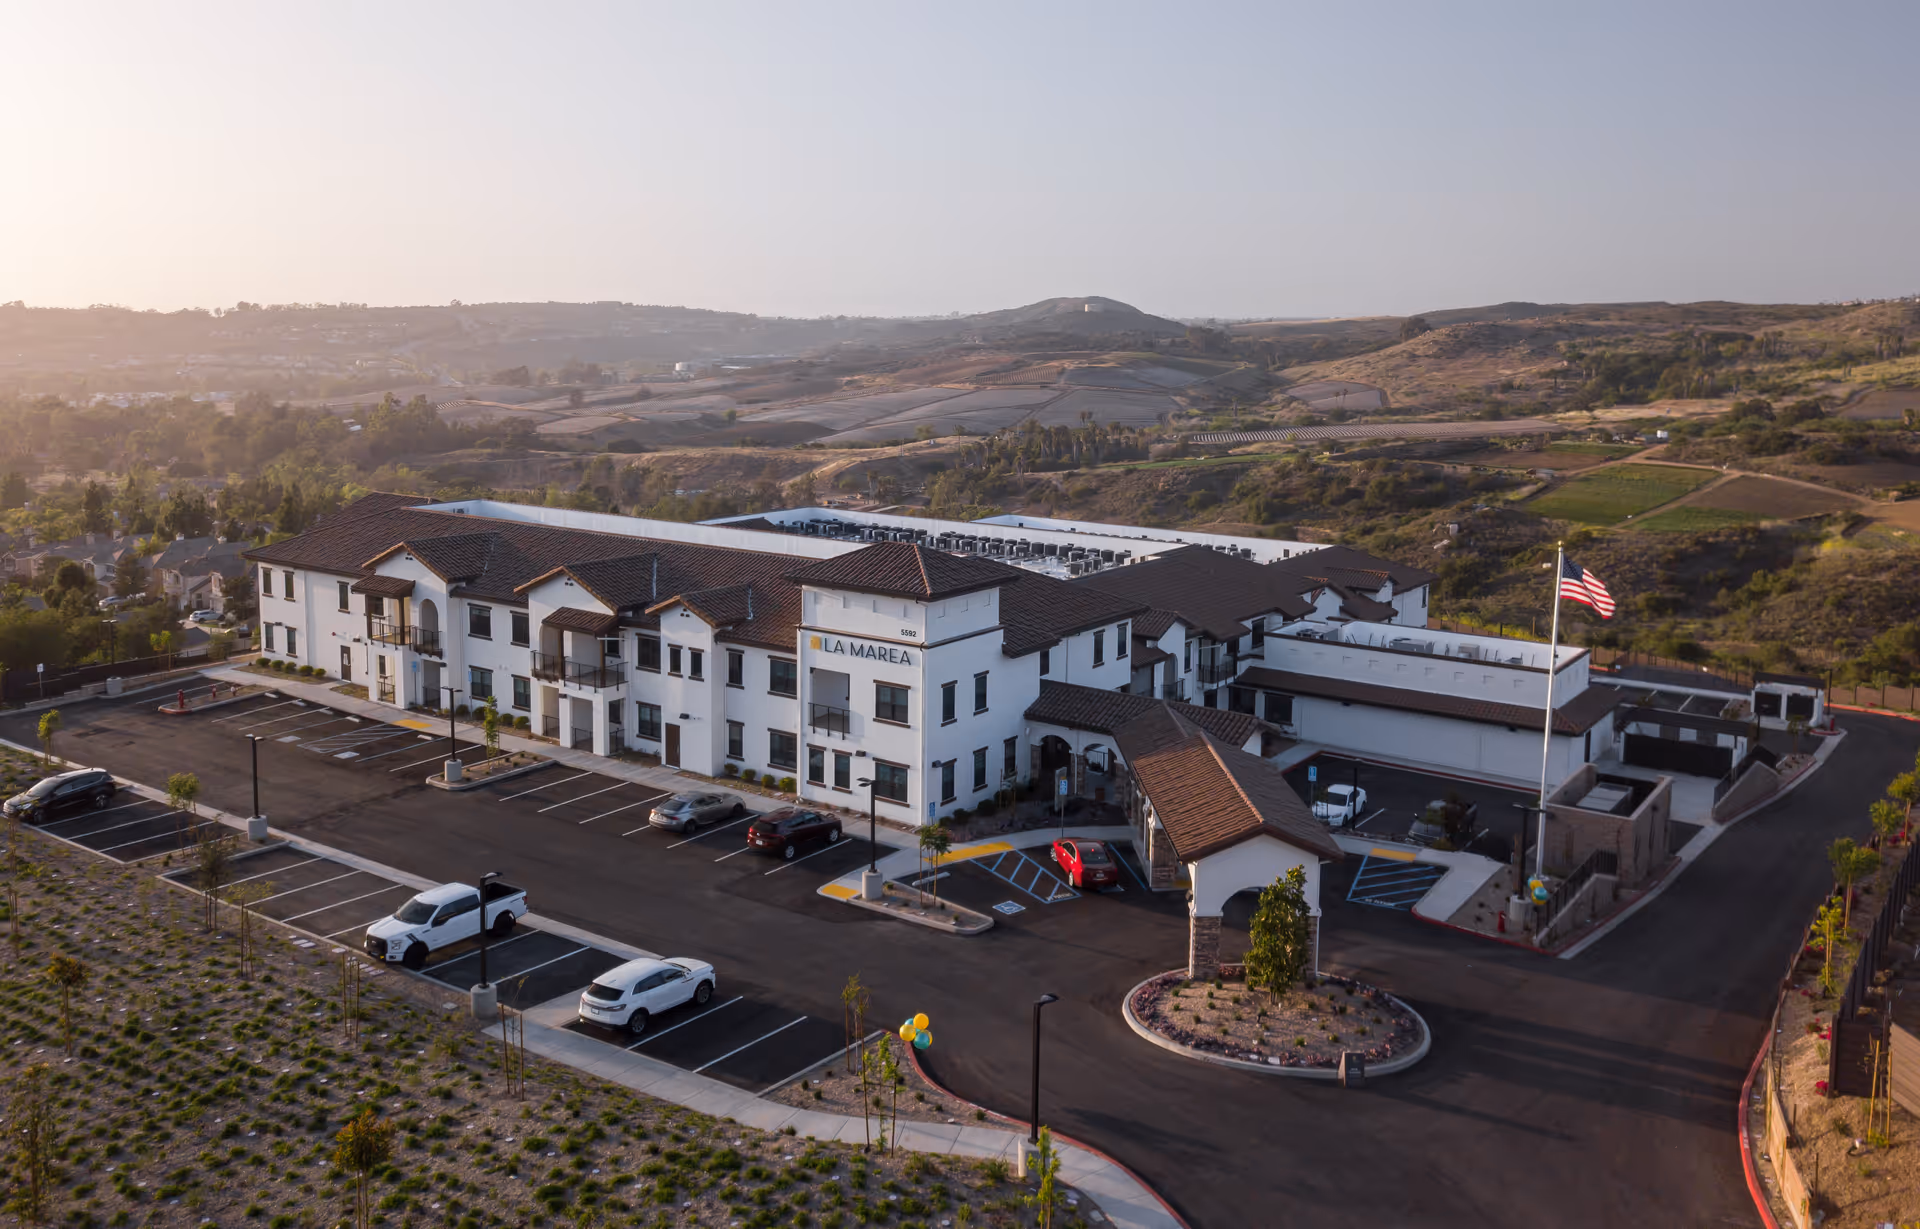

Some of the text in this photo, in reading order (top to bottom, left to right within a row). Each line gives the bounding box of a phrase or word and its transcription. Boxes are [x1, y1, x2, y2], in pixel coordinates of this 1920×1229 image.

[900, 629, 917, 638] 5592
[824, 637, 912, 666] LA MAREA
